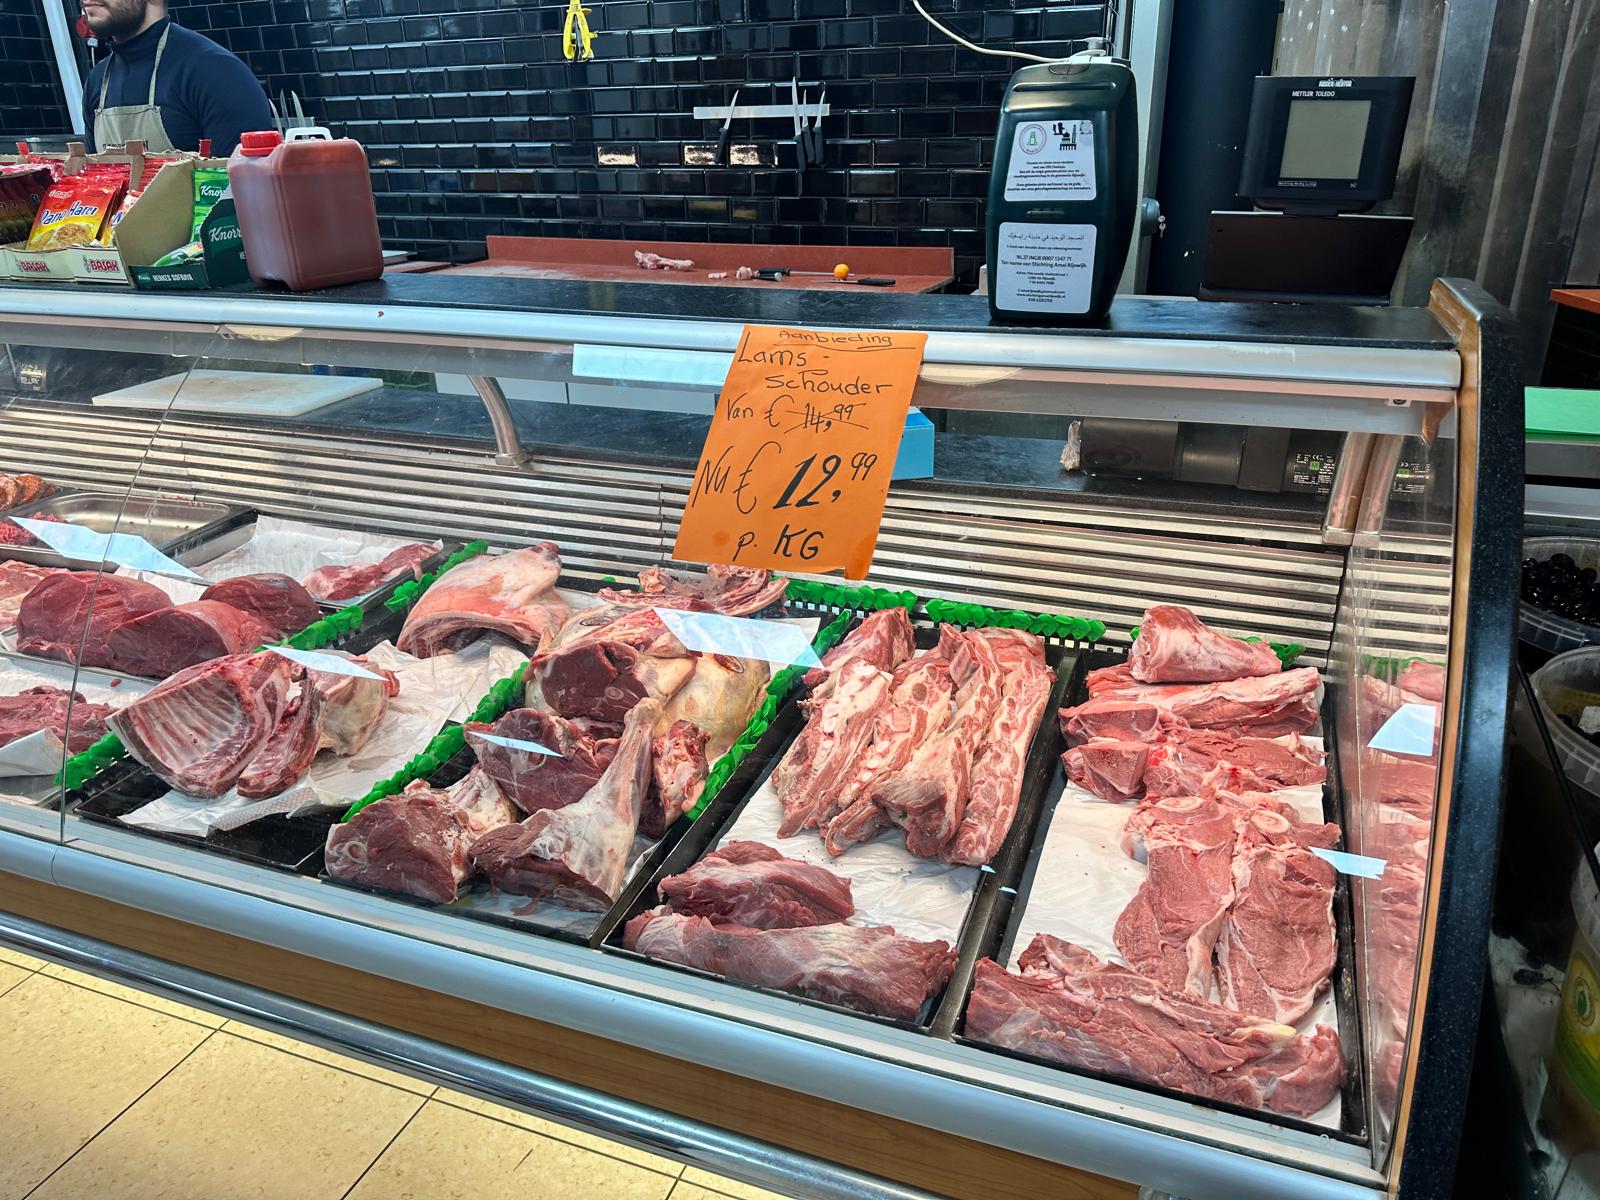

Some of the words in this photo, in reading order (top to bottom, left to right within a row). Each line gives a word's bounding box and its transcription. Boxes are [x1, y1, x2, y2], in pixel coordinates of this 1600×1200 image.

[738, 332, 808, 367] Lams
[765, 369, 895, 395] Schouder
[726, 392, 754, 421] Van
